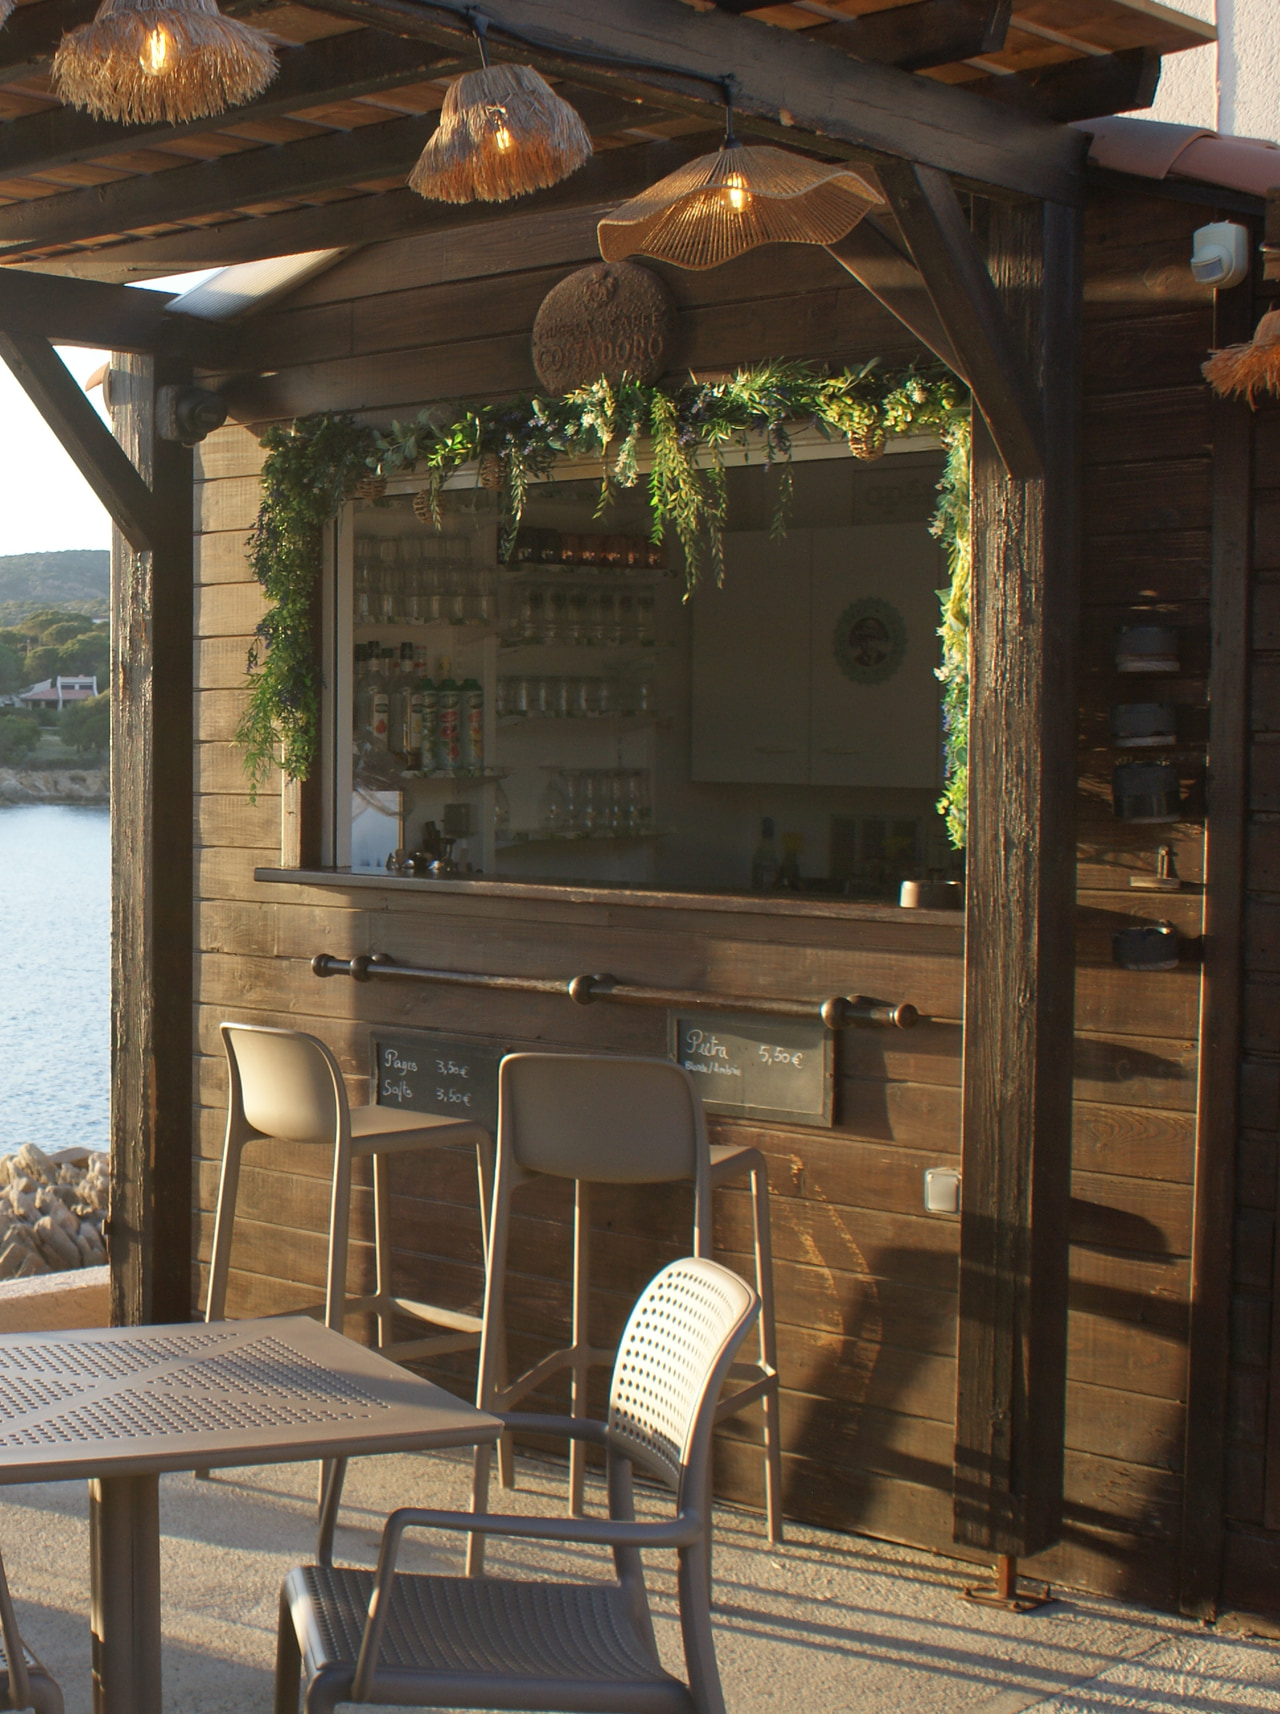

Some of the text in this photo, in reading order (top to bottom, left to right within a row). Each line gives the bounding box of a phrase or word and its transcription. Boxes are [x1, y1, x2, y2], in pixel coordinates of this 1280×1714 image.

[536, 331, 664, 374] COSTADORO
[758, 1045, 803, 1069] 5,50€
[434, 1059, 470, 1078] 3,50€
[435, 1087, 472, 1107] 3,50€
